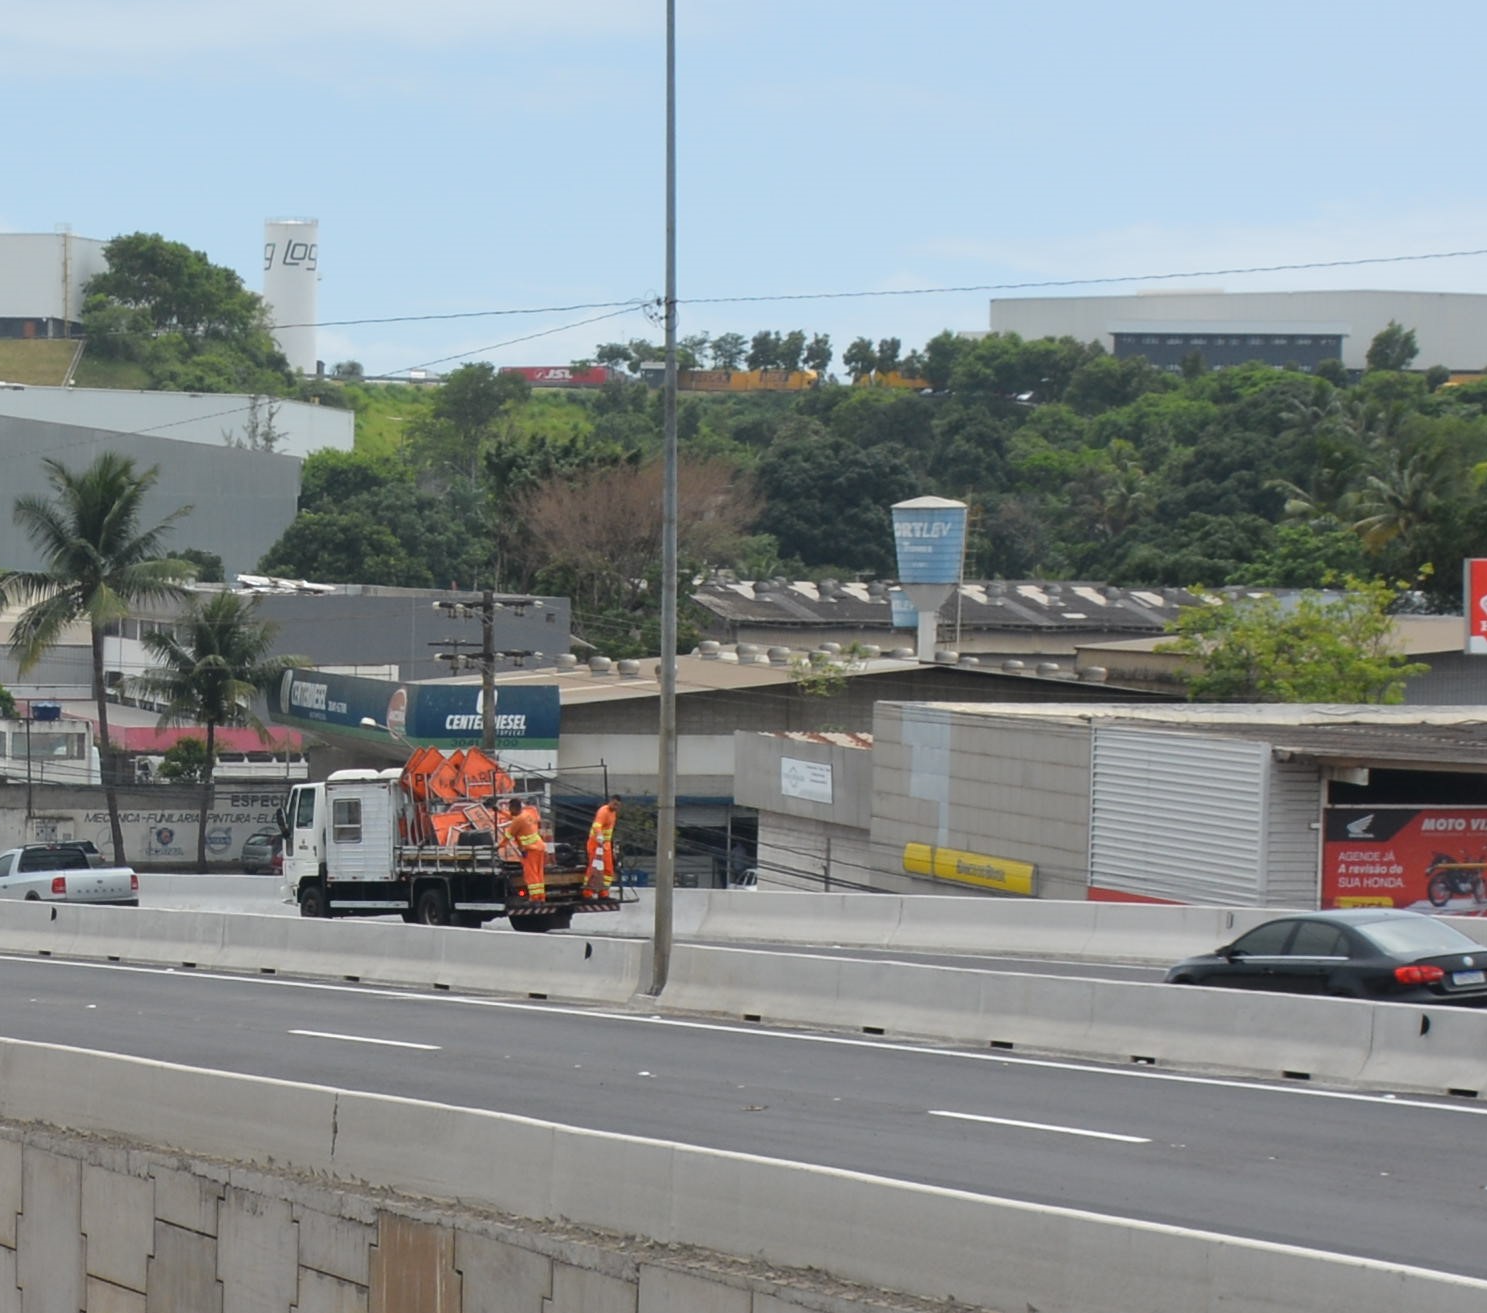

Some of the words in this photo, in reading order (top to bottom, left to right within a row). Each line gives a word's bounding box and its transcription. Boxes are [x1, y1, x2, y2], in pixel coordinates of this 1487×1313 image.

[1421, 818, 1466, 831] MOTO
[1338, 851, 1381, 862] AGENDE
[1382, 850, 1396, 862] JÁ
[1337, 864, 1346, 874] A
[1348, 863, 1388, 874] revisão
[1388, 863, 1404, 874] de
[1337, 876, 1362, 888] SUA
